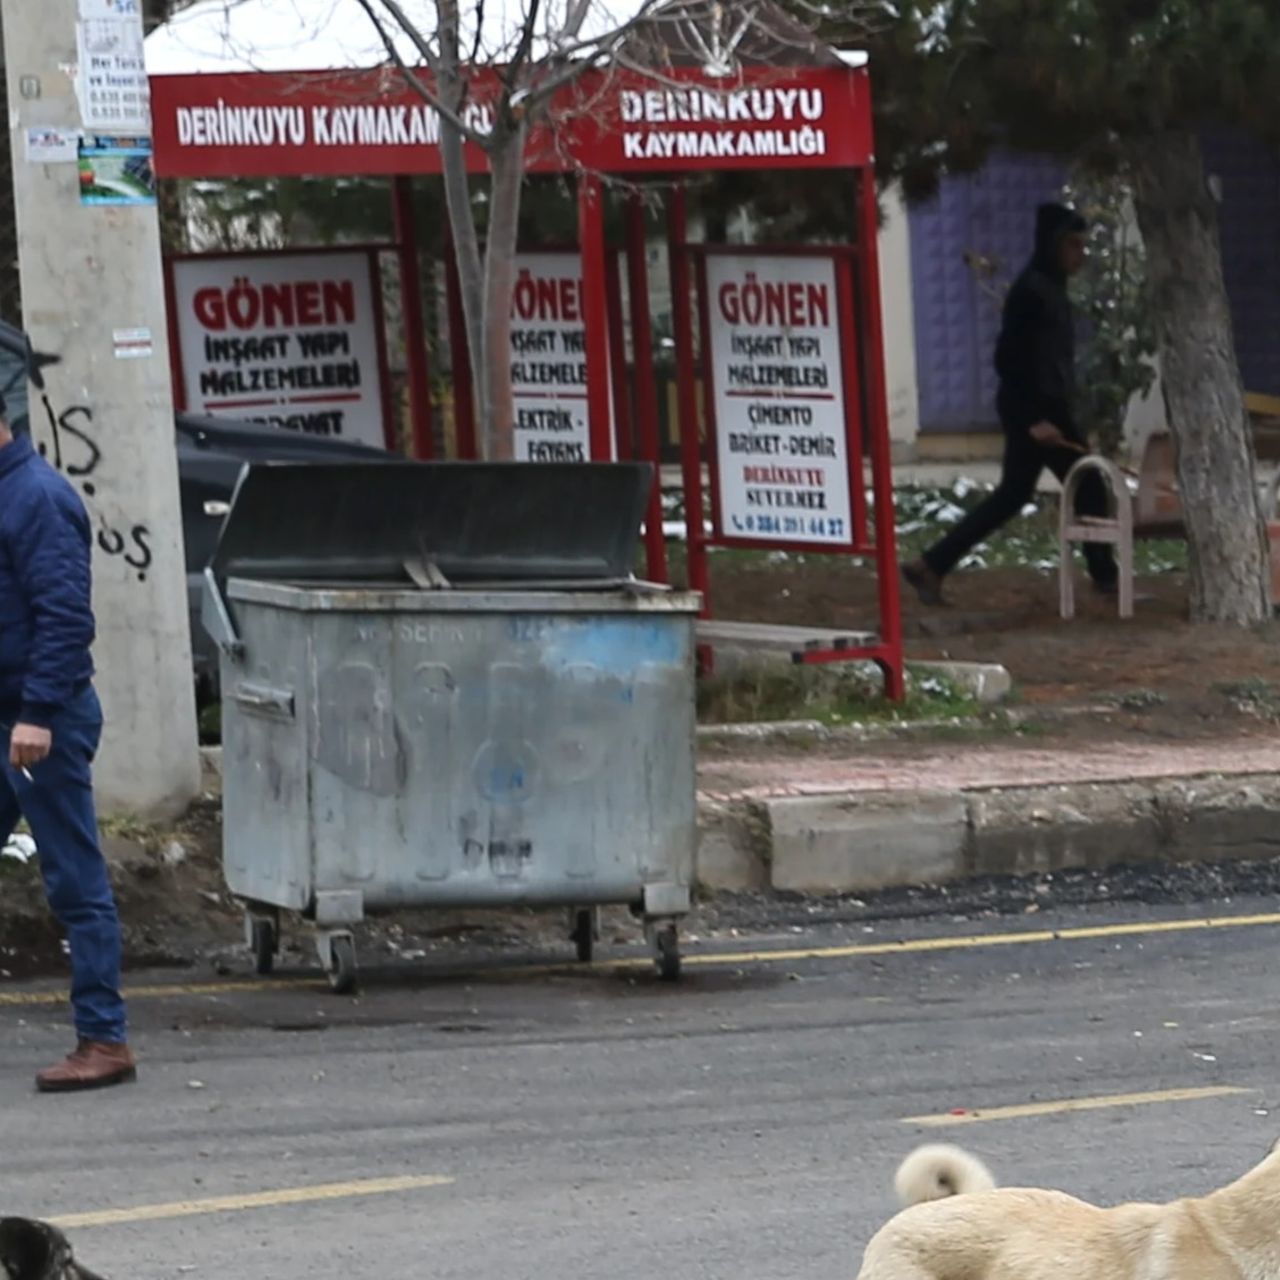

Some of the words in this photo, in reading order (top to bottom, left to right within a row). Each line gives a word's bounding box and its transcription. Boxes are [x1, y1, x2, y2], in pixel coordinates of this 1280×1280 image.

[177, 97, 305, 145] DERİNKUYU
[623, 125, 826, 158] KAYMAKAMLIĞI
[193, 276, 356, 331] GÖNEN
[510, 268, 585, 321] ÖNE
[719, 272, 829, 327] GÖNEN
[205, 331, 290, 367] İNŞAAT
[297, 330, 350, 358] YAPI
[510, 328, 556, 357] ŞAAT
[201, 357, 361, 396] MALZEMELERİ
[510, 362, 587, 384] ALZEMELE
[513, 405, 573, 433] EKTRİK
